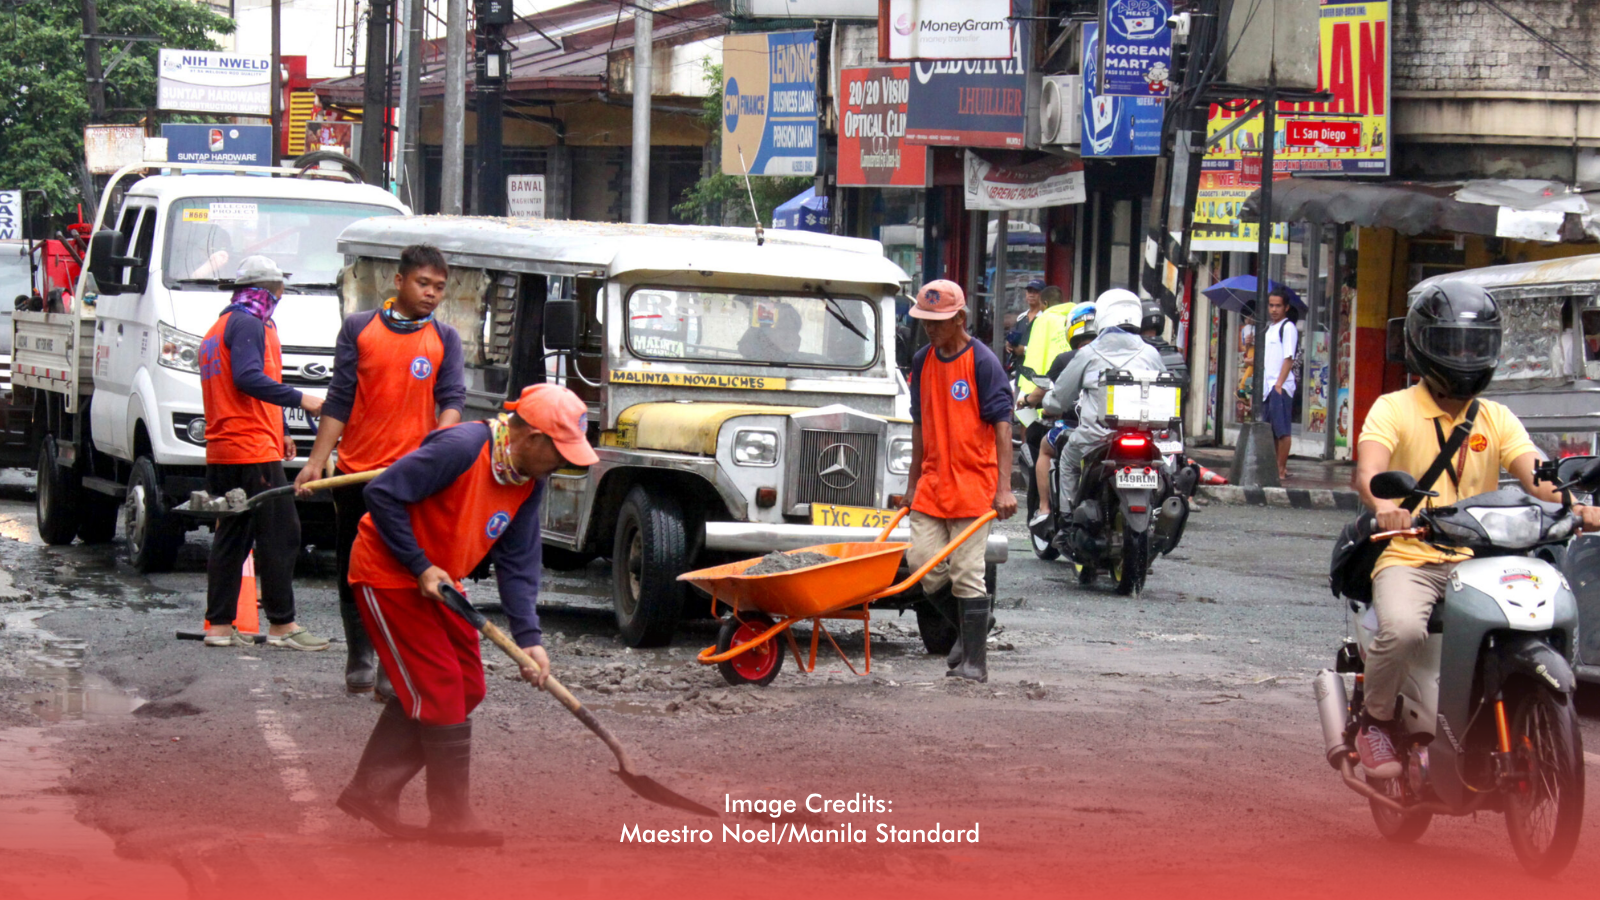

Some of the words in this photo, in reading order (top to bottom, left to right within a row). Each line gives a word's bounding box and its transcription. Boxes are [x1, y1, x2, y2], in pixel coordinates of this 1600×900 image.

[1118, 0, 1159, 15] APPA
[920, 19, 1004, 34] MoneyGram
[920, 36, 947, 44] money
[948, 34, 979, 43] transfer
[1106, 44, 1171, 57] KOREAN
[182, 55, 269, 71] NIHNWELD
[771, 42, 816, 84] LENDING
[1106, 57, 1149, 69] MART
[161, 87, 205, 100] SUNTAP
[206, 89, 268, 104] HARDWARE
[773, 90, 798, 113] BUSINESS
[798, 90, 814, 113] LOAN
[848, 79, 880, 109] 20/20
[958, 86, 1022, 117] LHUILLIER
[161, 100, 178, 108] AND
[180, 101, 237, 111] CONSTRUCTION
[740, 95, 765, 116] FINANCE
[844, 110, 884, 137] OPTICAL
[773, 125, 797, 148] PENSION
[797, 125, 813, 148] LOAN
[1293, 128, 1300, 139] L.
[1302, 128, 1318, 140] San
[1321, 128, 1346, 142] Diego
[178, 153, 210, 162] SUNTAP
[211, 153, 257, 162] HARDWARE
[1287, 160, 1300, 171] AND
[511, 180, 543, 192] BAWAL
[1217, 172, 1235, 187] WE
[1199, 190, 1219, 198] GADGETS
[1220, 190, 1246, 198] APPLIANCES
[613, 370, 670, 384] MALINTA
[683, 374, 765, 389] NOVALICHES
[1118, 474, 1156, 483] 149RLM
[821, 509, 851, 527] TXC
